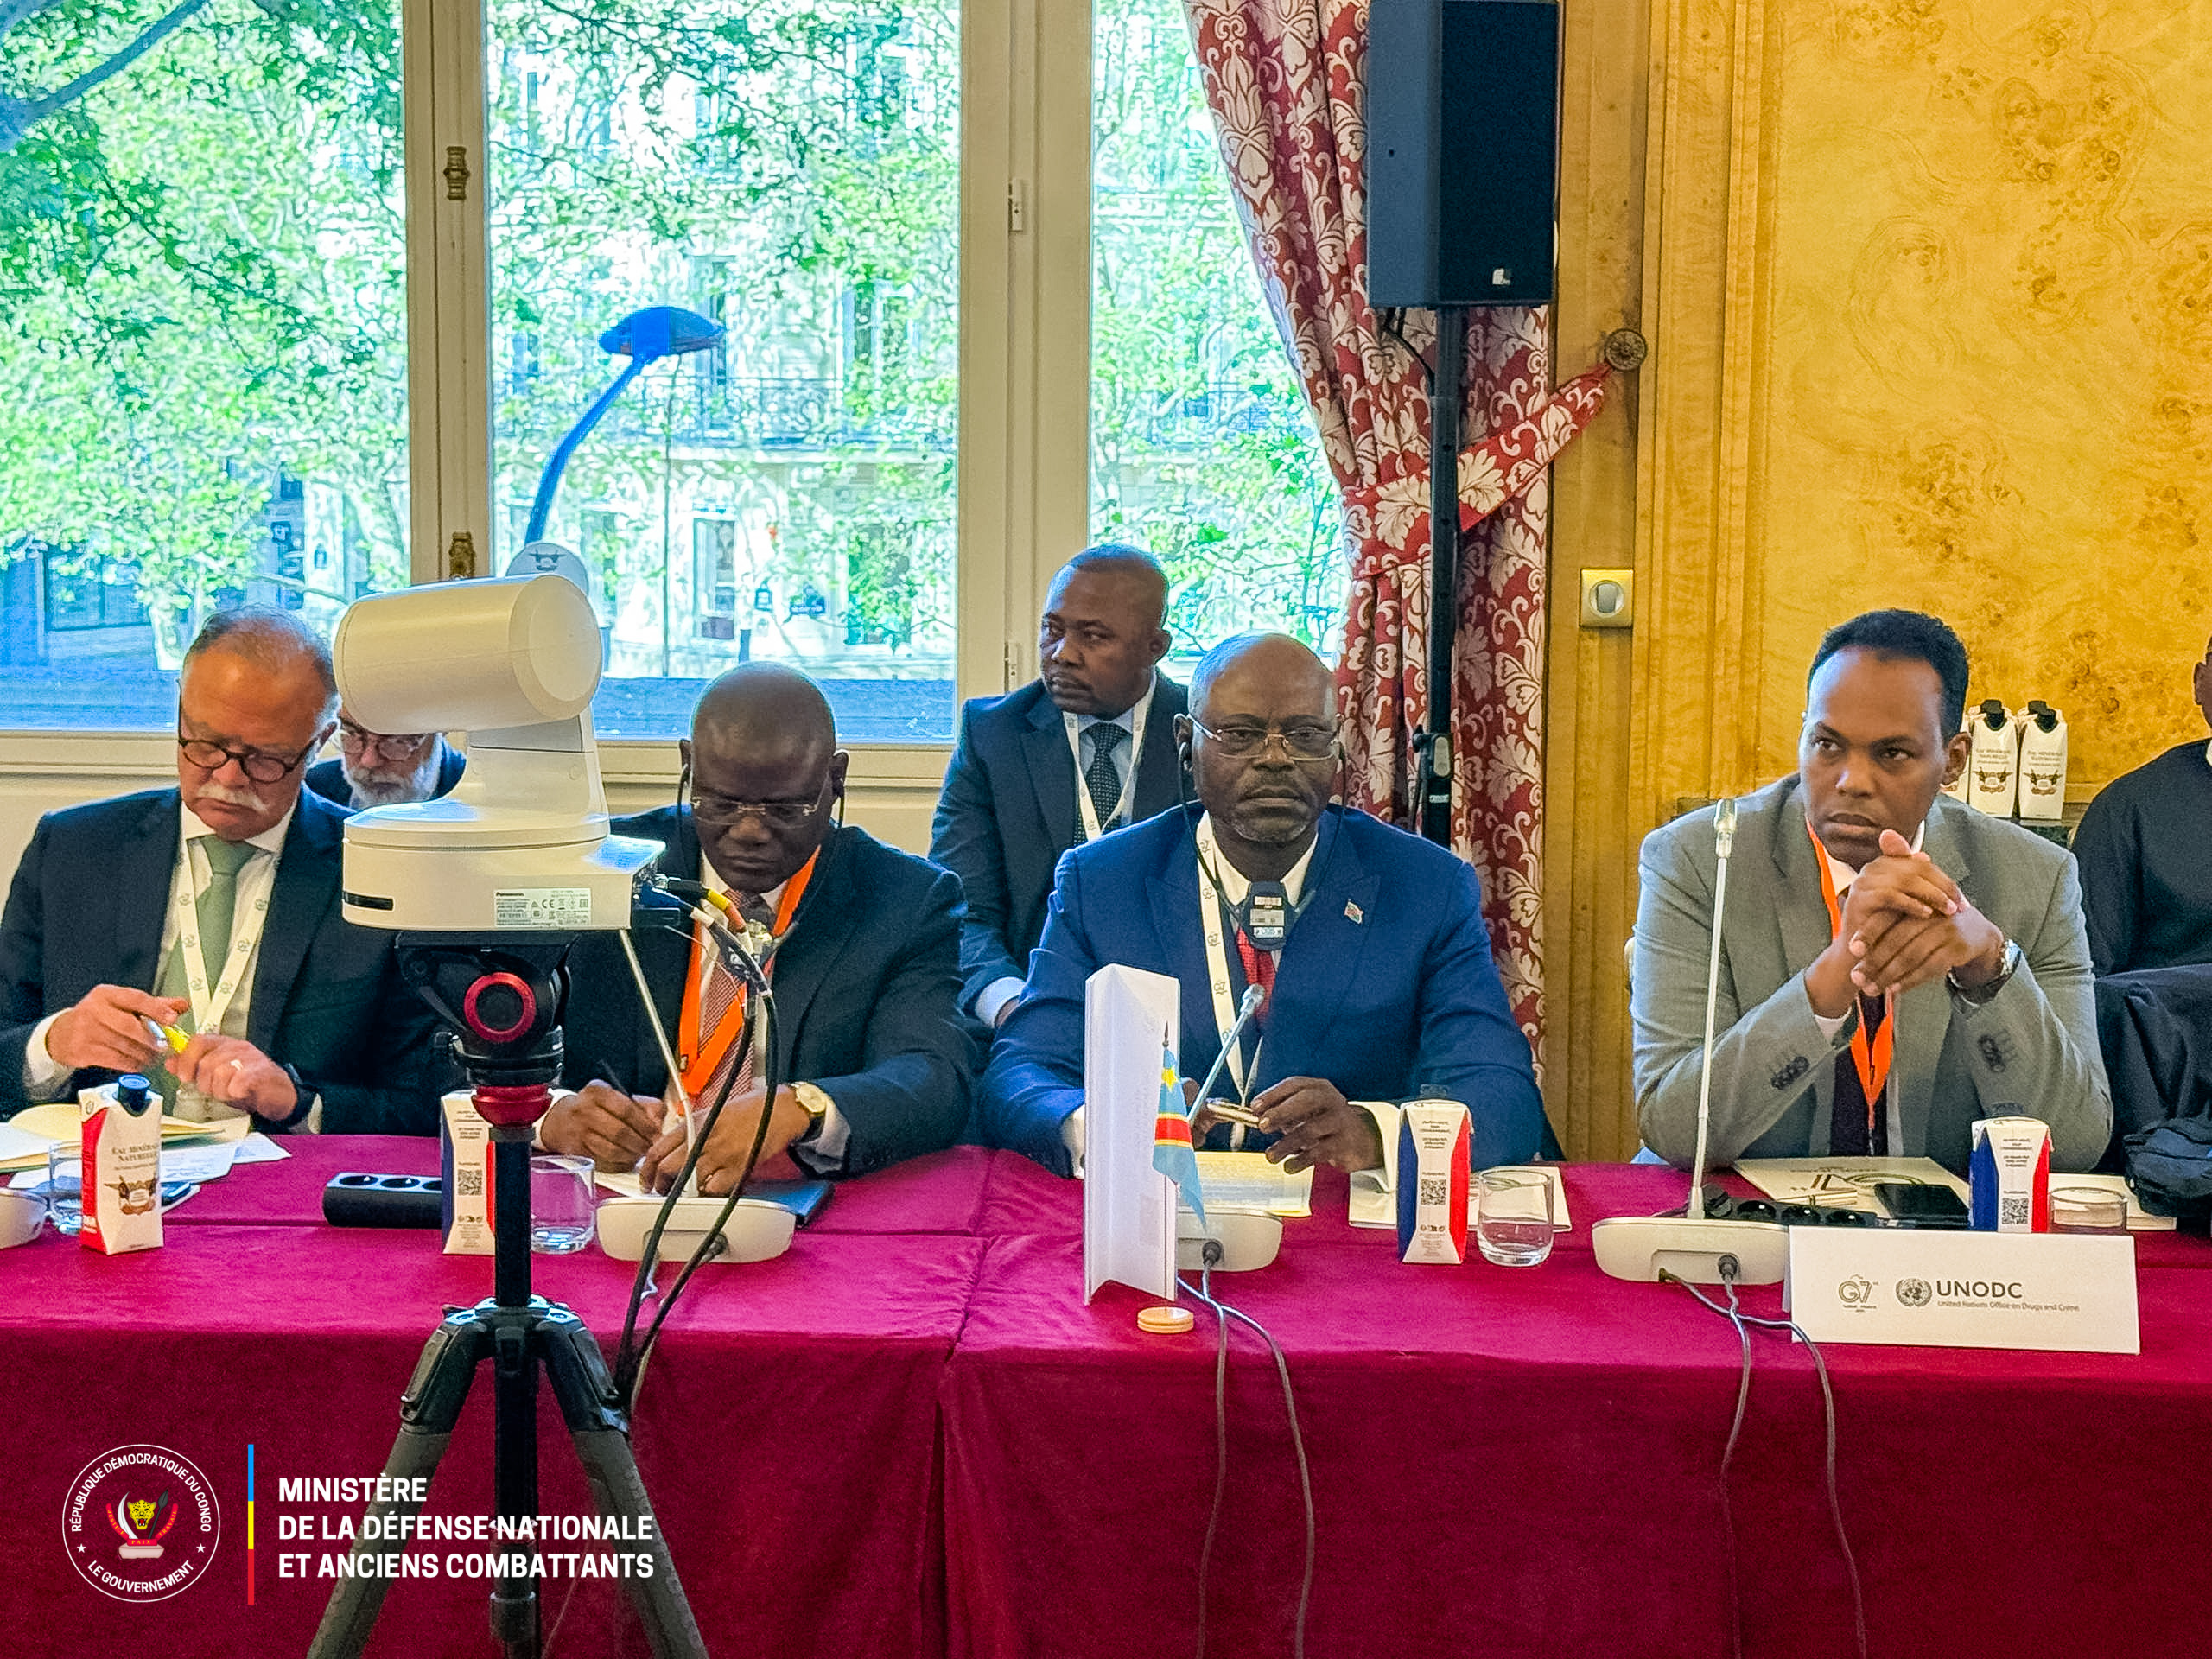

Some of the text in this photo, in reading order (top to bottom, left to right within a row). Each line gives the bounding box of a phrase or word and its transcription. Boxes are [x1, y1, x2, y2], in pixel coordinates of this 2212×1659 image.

[1838, 1280, 1872, 1303] G7
[1936, 1280, 2023, 1299] UNODC
[2022, 1302, 2043, 1312] Drugs
[2058, 1304, 2080, 1313] Crime
